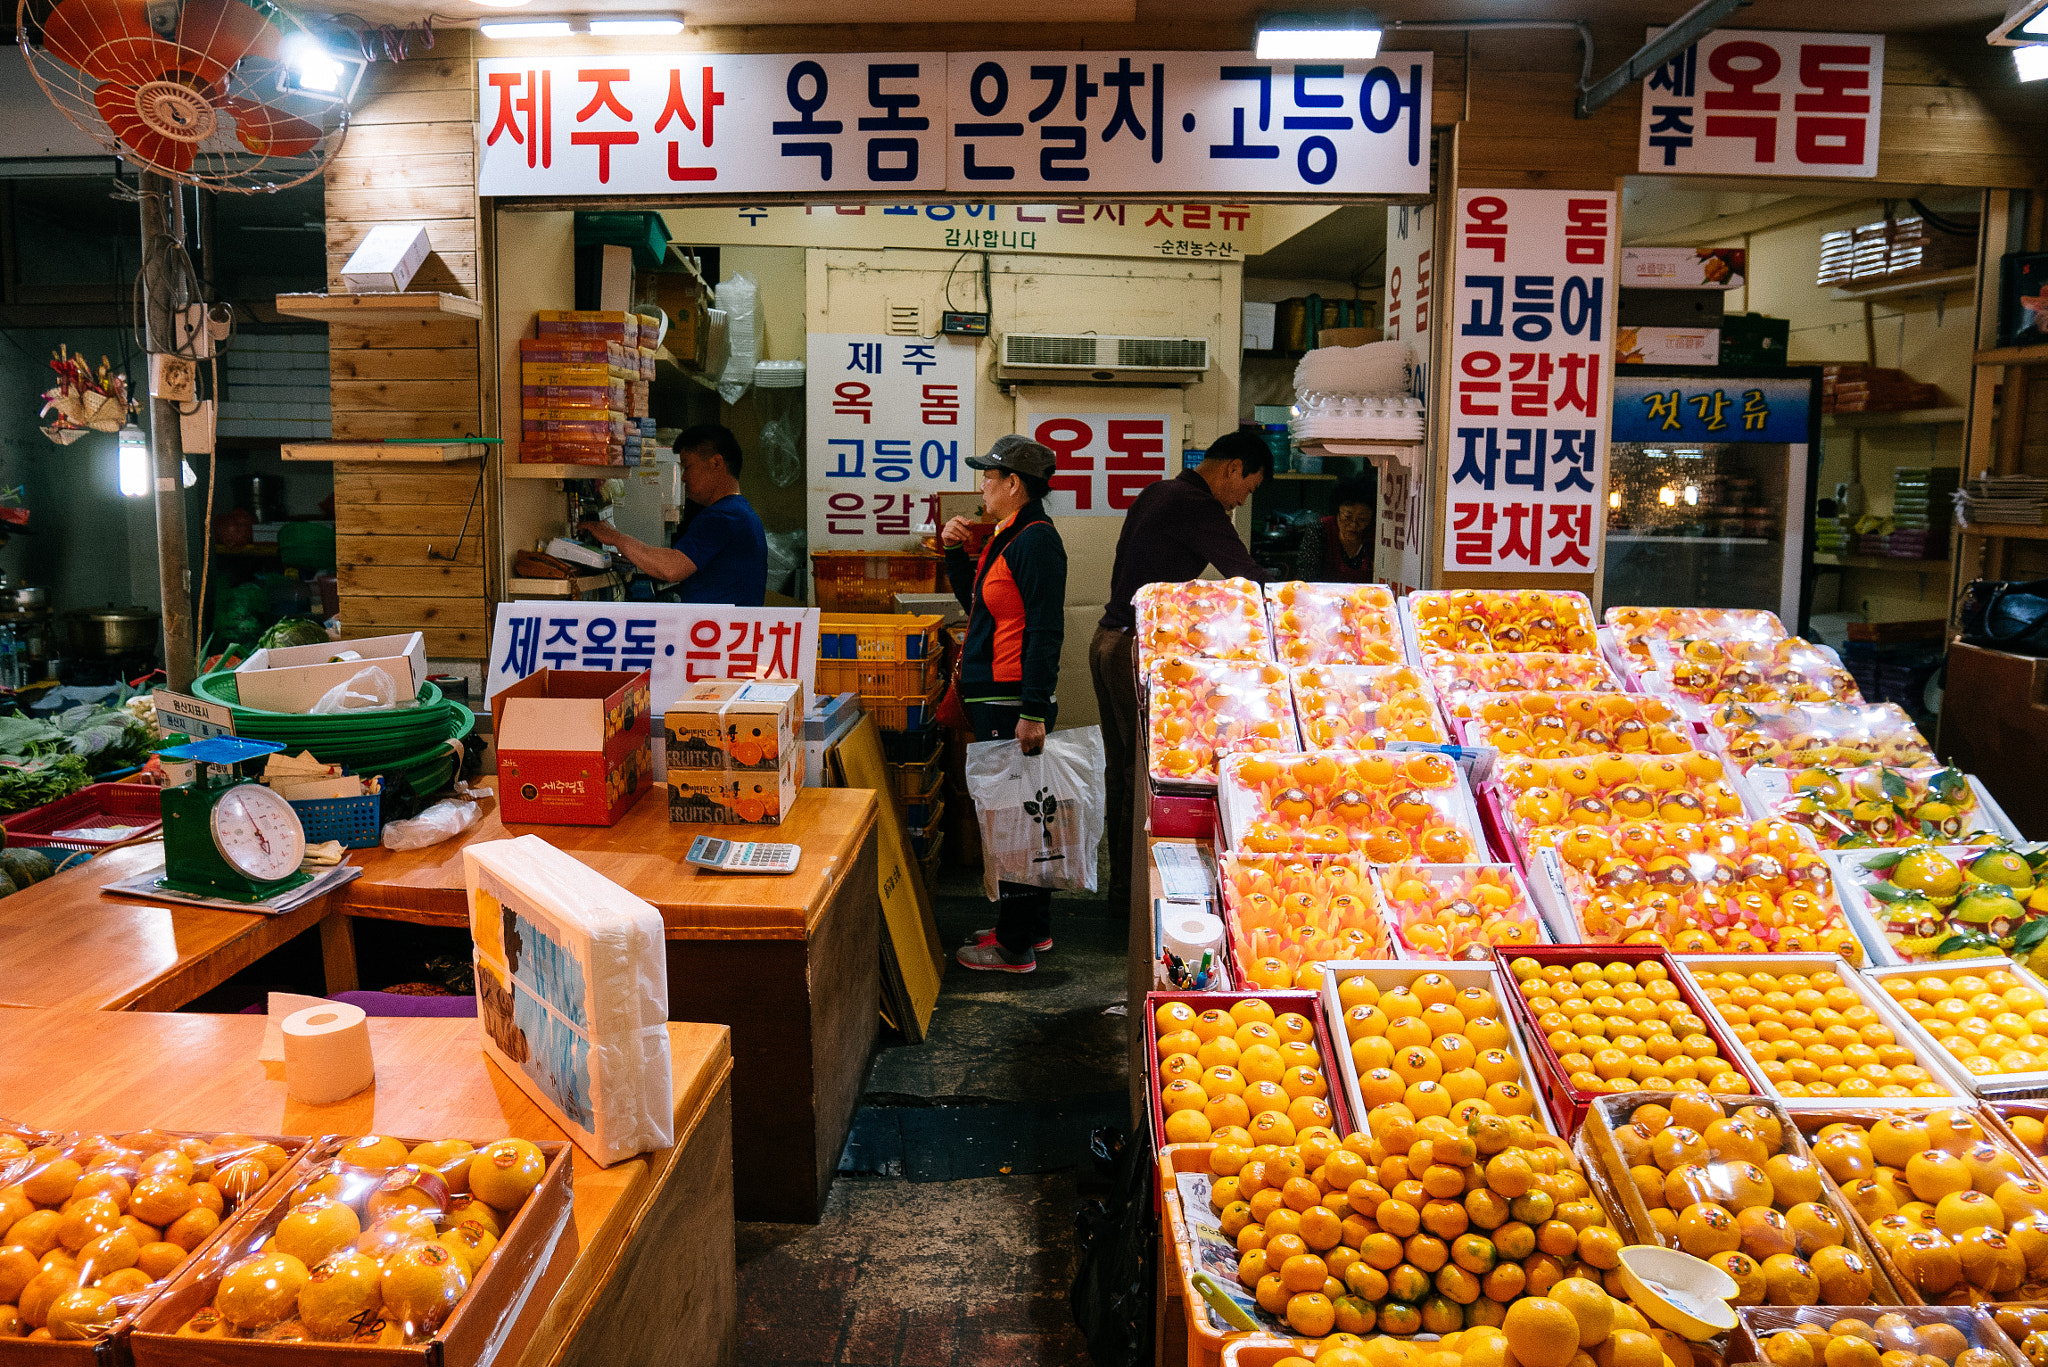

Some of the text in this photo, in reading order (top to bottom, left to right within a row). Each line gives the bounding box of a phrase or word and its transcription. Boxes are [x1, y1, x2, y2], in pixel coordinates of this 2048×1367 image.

[486, 65, 725, 184] 제주산
[772, 60, 930, 182] 옥돔
[1704, 40, 1872, 165] 옥돔
[944, 228, 1037, 250] 감사합니다
[1461, 275, 1605, 343] 고등어
[1458, 350, 1600, 418] 은갈치
[1643, 390, 1770, 432] 젓갈류
[825, 438, 958, 483] 고등어
[1034, 418, 1166, 510] 옥돔
[1452, 427, 1597, 493] 자리젓
[1452, 502, 1593, 568] 갈치젓
[172, 699, 210, 720] 원산지표시
[666, 750, 710, 767] FRUITS
[669, 806, 713, 823] FRUITS
